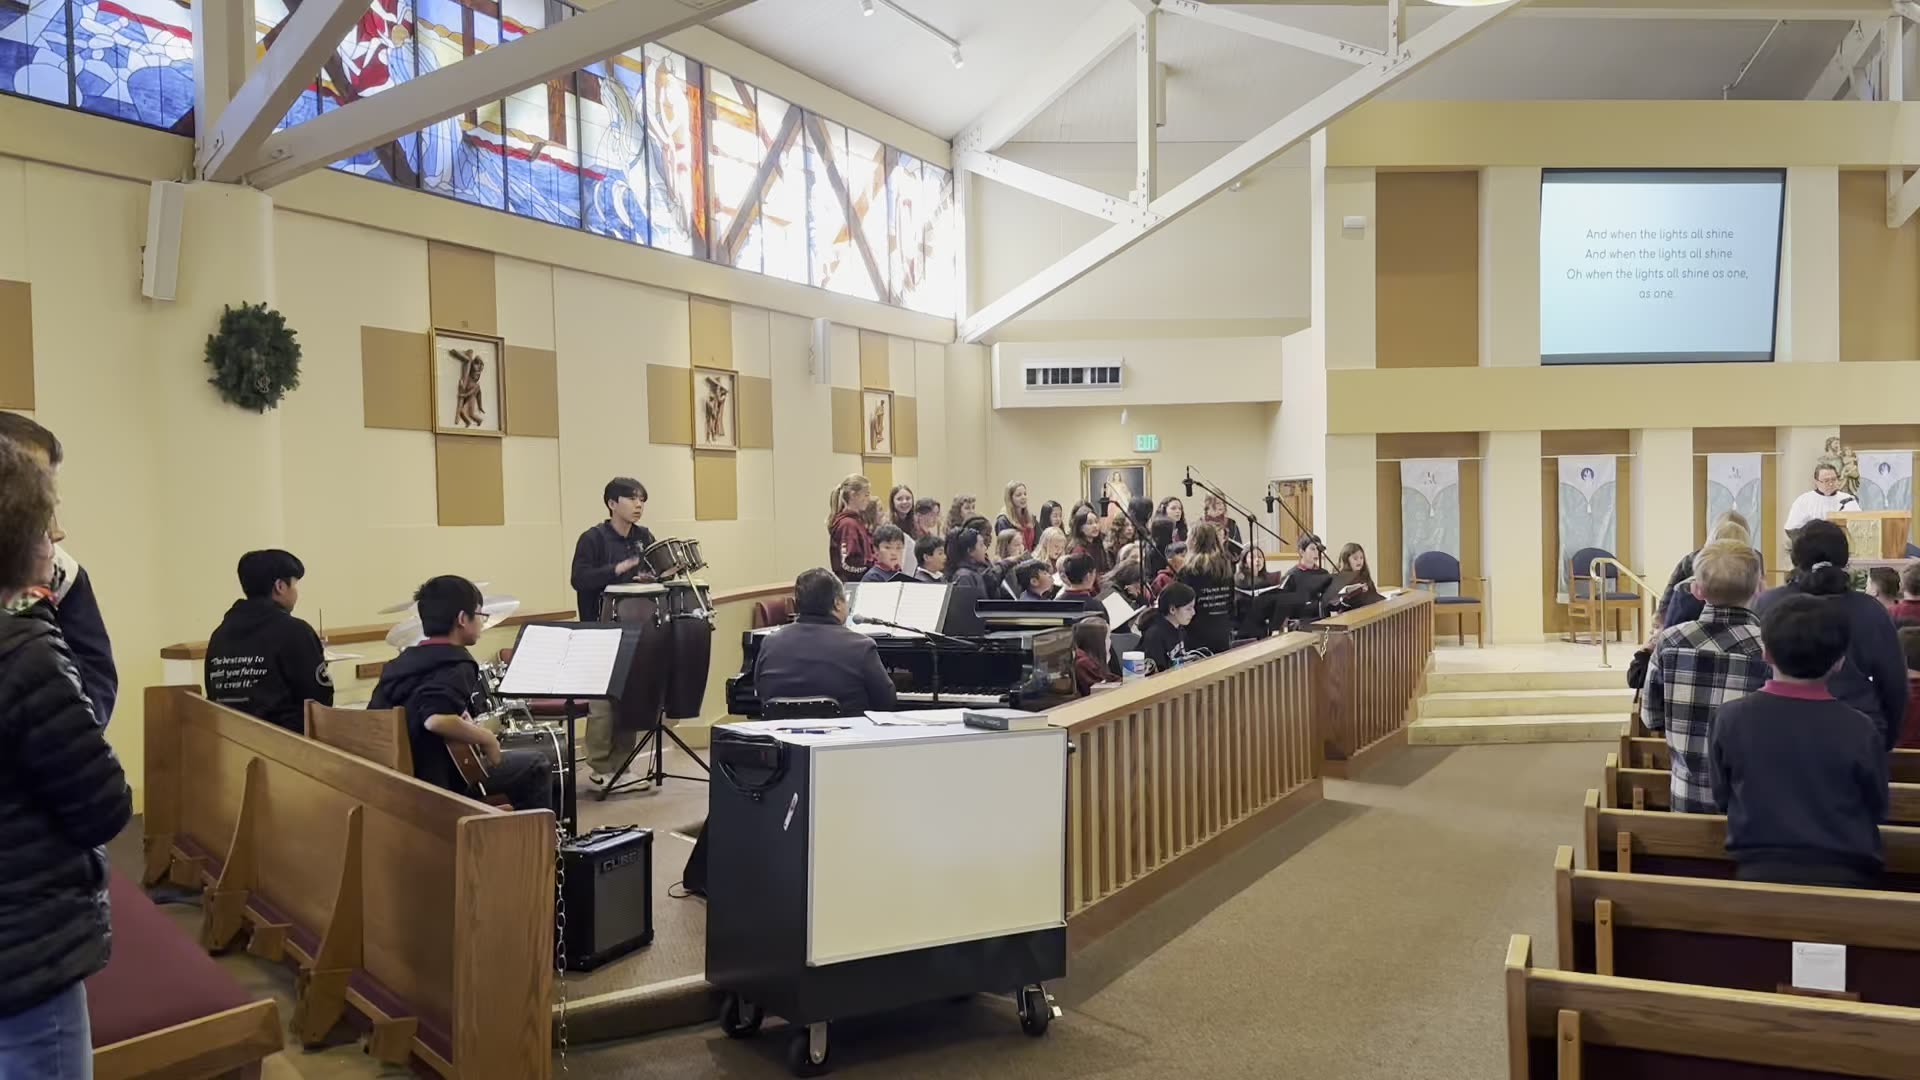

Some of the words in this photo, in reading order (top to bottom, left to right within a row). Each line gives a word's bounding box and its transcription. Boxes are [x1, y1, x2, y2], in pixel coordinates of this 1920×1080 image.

[1586, 229, 1608, 239] And
[1610, 229, 1637, 239] when
[1640, 229, 1657, 239] the
[1659, 229, 1688, 242] lights
[1690, 229, 1704, 239] all
[1706, 229, 1734, 239] shine
[1585, 249, 1607, 259] And
[1609, 249, 1636, 259] when
[1639, 249, 1656, 259] the
[1658, 249, 1687, 261] lights
[1689, 248, 1703, 259] all
[1704, 248, 1733, 259] shine
[1566, 268, 1582, 280] Oh
[1585, 269, 1613, 280] when
[1616, 269, 1633, 279] the
[1635, 269, 1664, 281] lights
[1666, 269, 1679, 279] all
[1681, 268, 1710, 279] shine
[1712, 270, 1725, 278] as
[1727, 270, 1749, 280] one,
[1639, 289, 1651, 299] as
[240, 666, 268, 678] future
